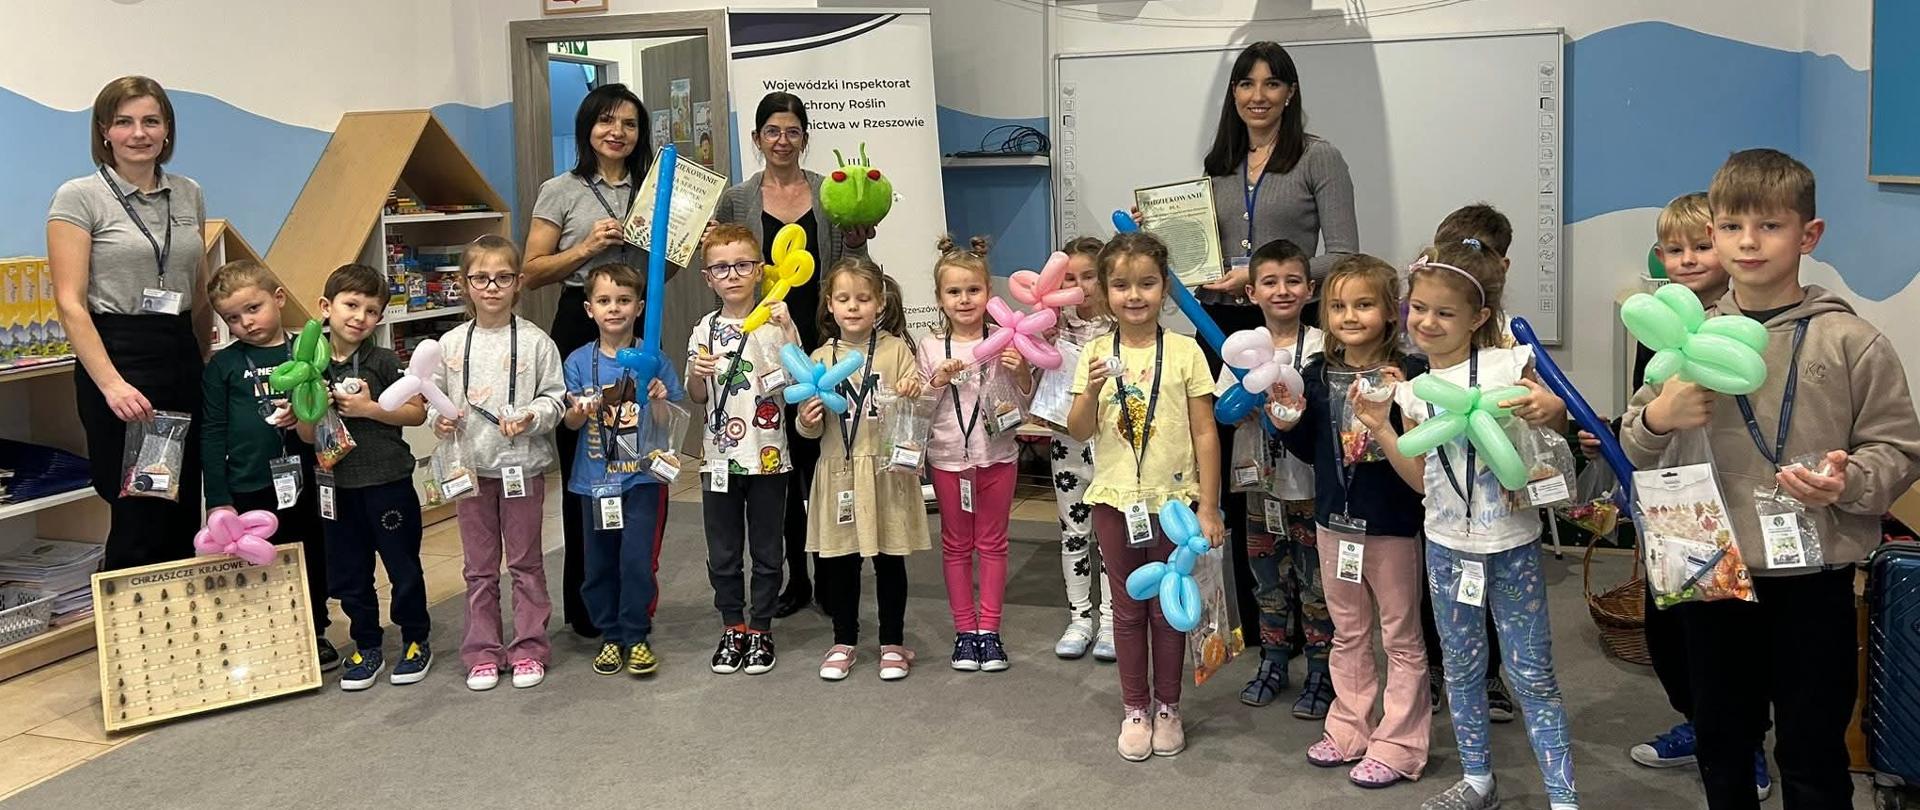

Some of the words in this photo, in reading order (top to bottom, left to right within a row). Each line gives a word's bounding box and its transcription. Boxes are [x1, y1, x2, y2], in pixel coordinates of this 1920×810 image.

[763, 79, 839, 92] Wojewódzki
[842, 78, 911, 93] Inspektorat
[804, 99, 845, 111] chrony
[849, 98, 886, 109] Roślin
[806, 119, 846, 130] nictwa
[848, 121, 860, 129] w
[863, 117, 925, 129] Rzeszowie
[130, 568, 194, 586] CHRZĄSZCZE
[198, 560, 244, 575] KRAJOWE
